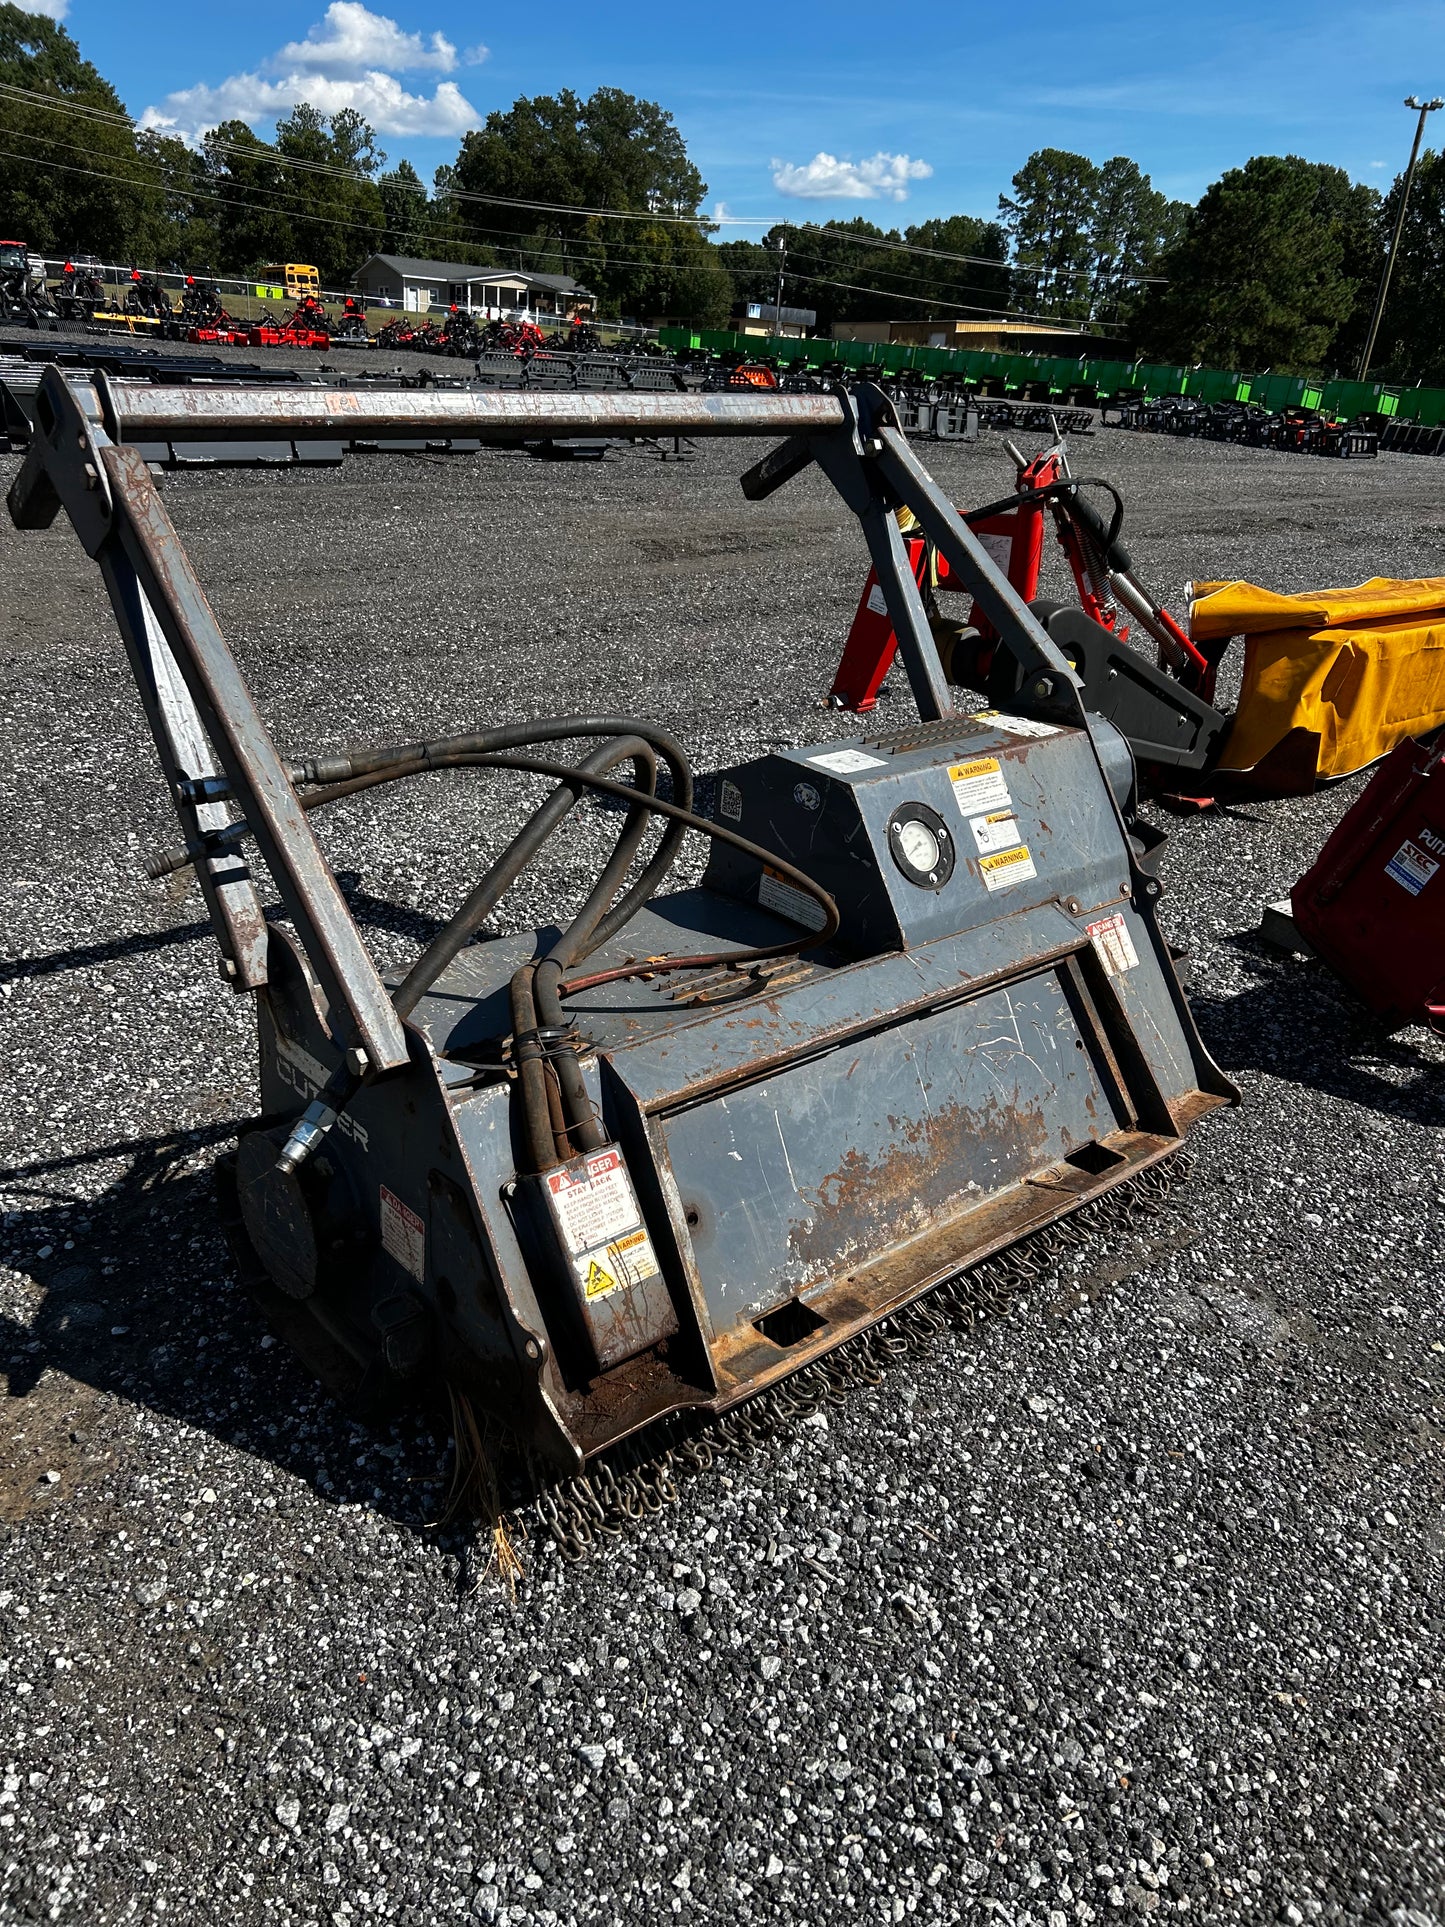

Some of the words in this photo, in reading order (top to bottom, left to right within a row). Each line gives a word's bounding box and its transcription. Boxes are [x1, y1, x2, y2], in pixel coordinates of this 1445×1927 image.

[964, 762, 992, 776] WARNING
[1418, 828, 1445, 855] PUM
[994, 852, 1024, 866] WARNING
[567, 1184, 587, 1197] STAY
